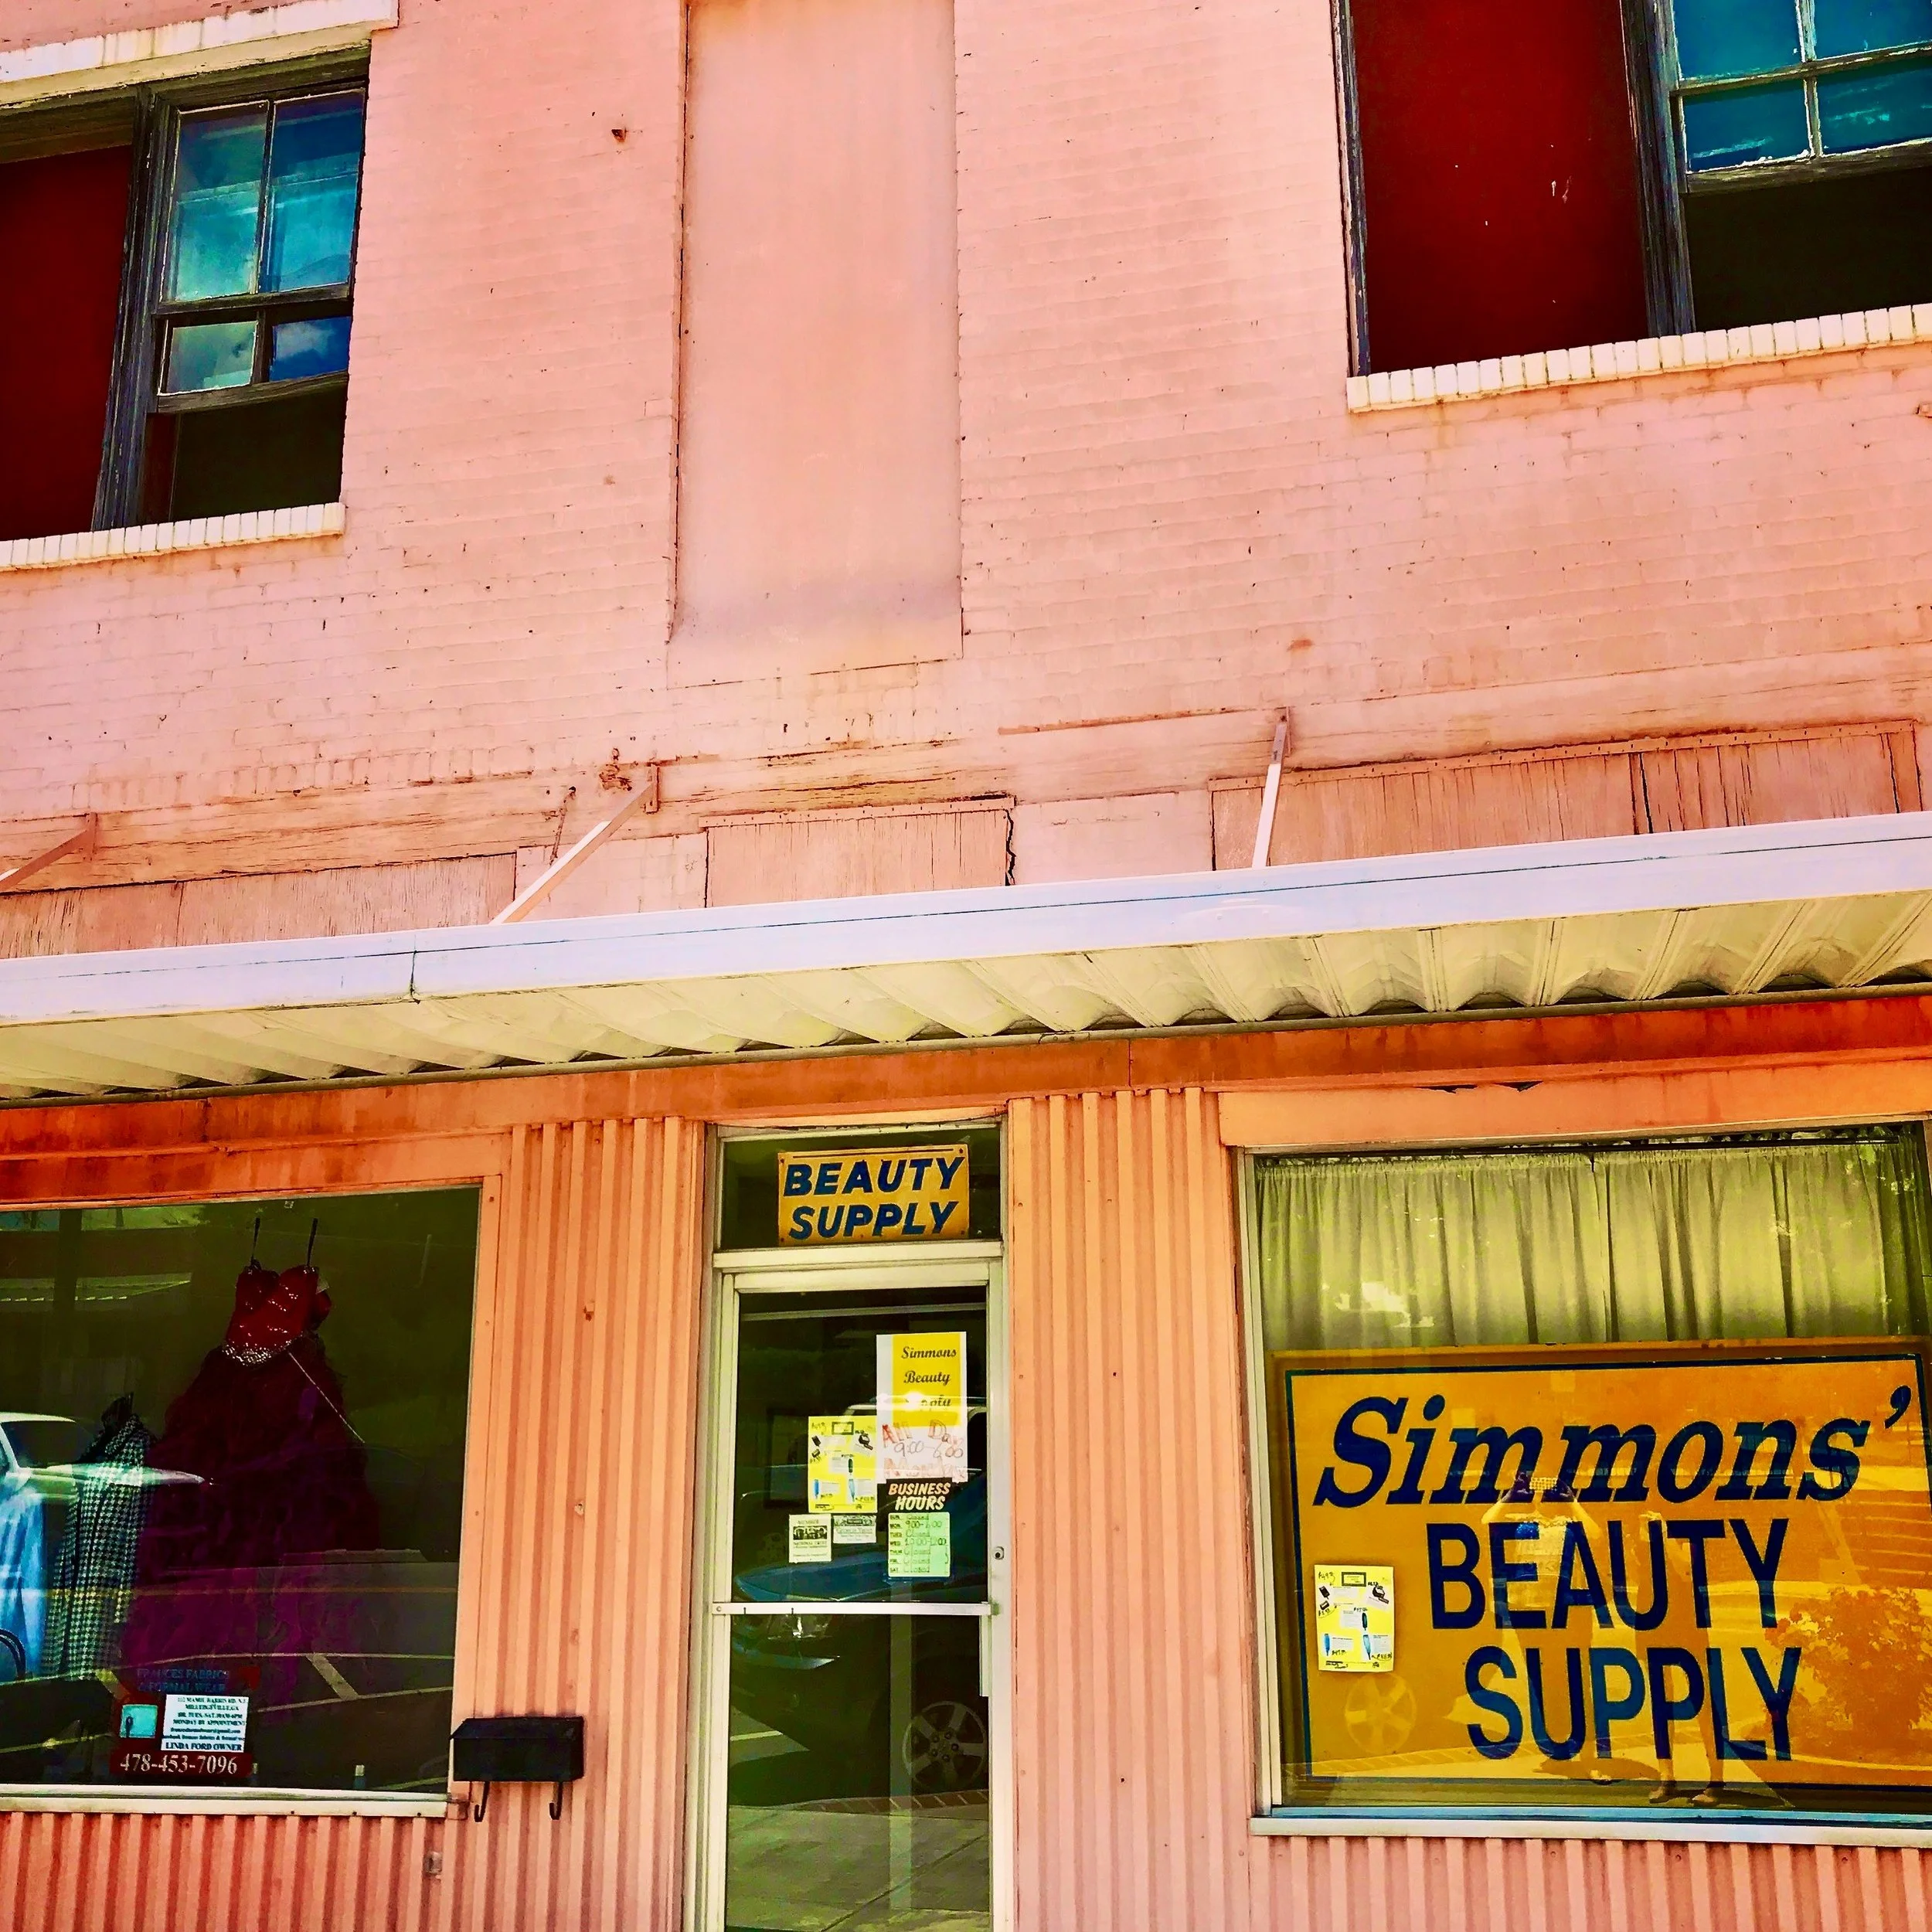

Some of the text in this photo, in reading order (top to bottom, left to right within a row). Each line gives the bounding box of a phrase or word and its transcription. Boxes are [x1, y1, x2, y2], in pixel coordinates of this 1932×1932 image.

[784, 1157, 965, 1197] BEAUTY
[788, 1201, 958, 1240] SUPPLY
[901, 1346, 957, 1359] Simmons
[903, 1370, 950, 1386] Beauty
[1314, 1384, 1912, 1509] Simmons'
[888, 1482, 951, 1496] BUSINESS
[895, 1495, 946, 1511] HOURS
[1427, 1519, 1789, 1631] BEAUTY
[1465, 1646, 1801, 1761] SUPPLY
[213, 1743, 243, 1751] OWNER
[120, 1753, 238, 1774] 478-453-7096
